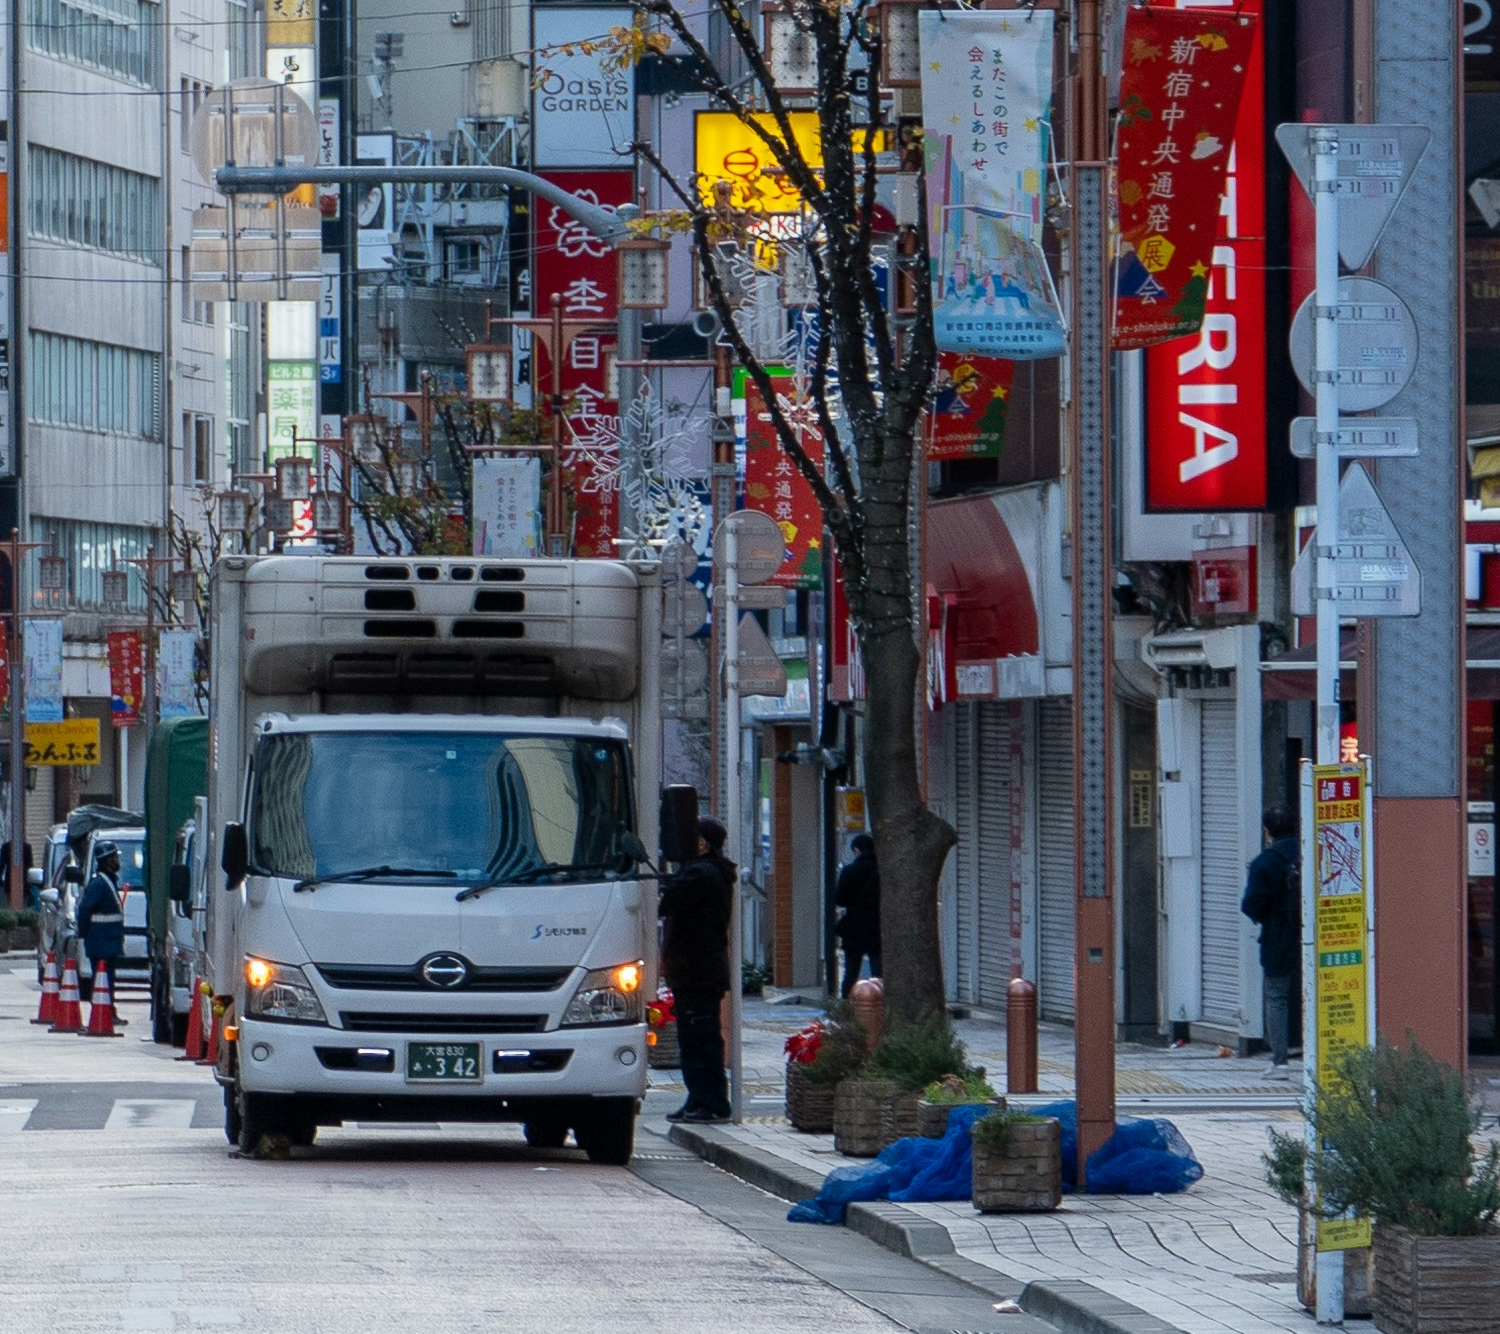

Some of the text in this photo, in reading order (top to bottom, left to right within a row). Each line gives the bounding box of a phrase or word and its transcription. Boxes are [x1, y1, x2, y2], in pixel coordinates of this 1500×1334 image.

[991, 48, 1009, 156] またこの街で
[1135, 35, 1202, 307] 新宿中央通発展会
[272, 387, 300, 439] 薬局
